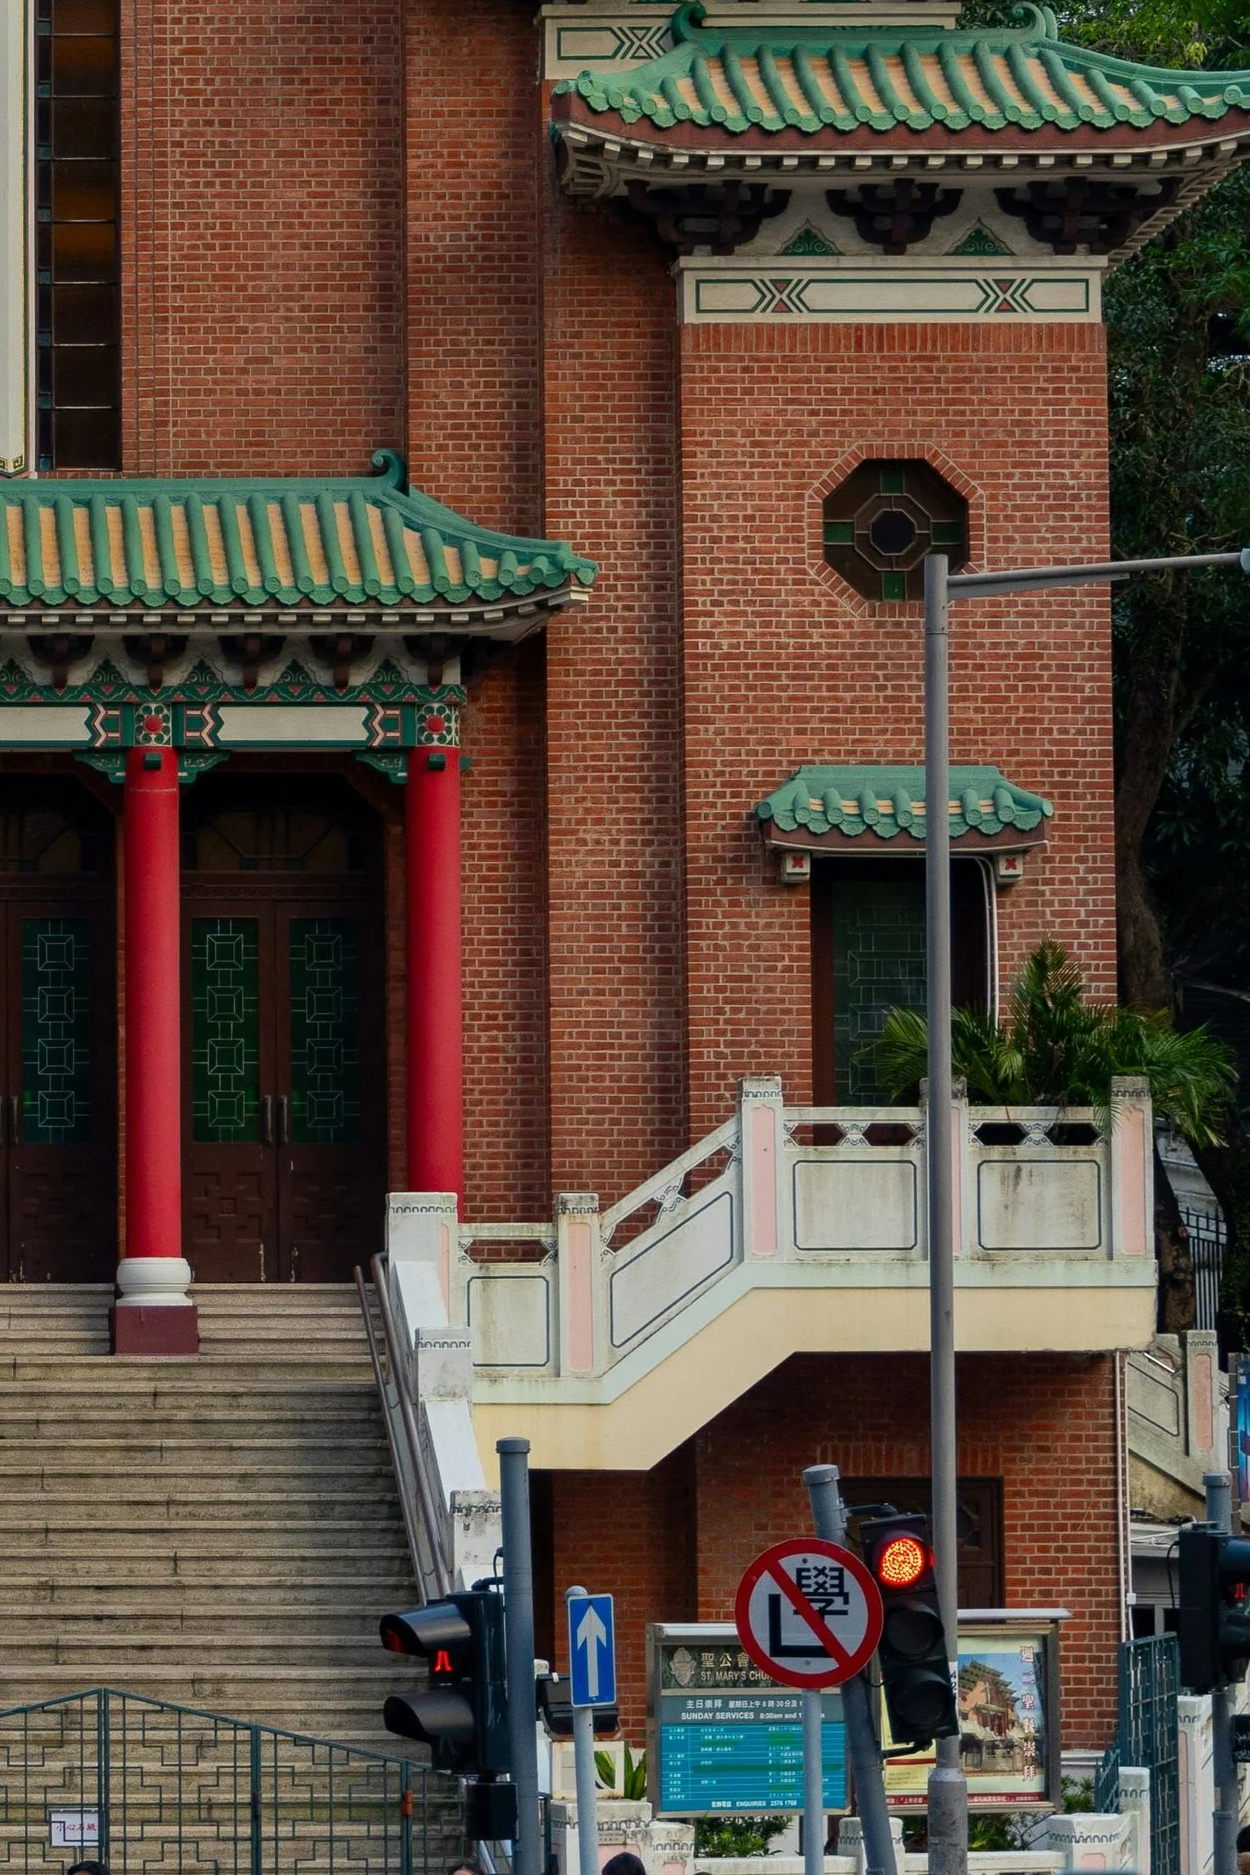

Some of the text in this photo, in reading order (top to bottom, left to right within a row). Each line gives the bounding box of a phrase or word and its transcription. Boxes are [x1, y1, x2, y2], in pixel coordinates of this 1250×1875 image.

[794, 1566, 849, 1623] 學
[768, 1594, 835, 1658] L
[701, 1652, 757, 1668] 聖公會
[701, 1672, 713, 1681] ST.
[715, 1671, 747, 1681] MARY'S
[686, 1699, 723, 1709] 主日崇拜
[681, 1712, 713, 1720] SUNDAY
[715, 1711, 755, 1720] SERVICES
[1020, 1645, 1037, 1782] 週二聖餐崇拜
